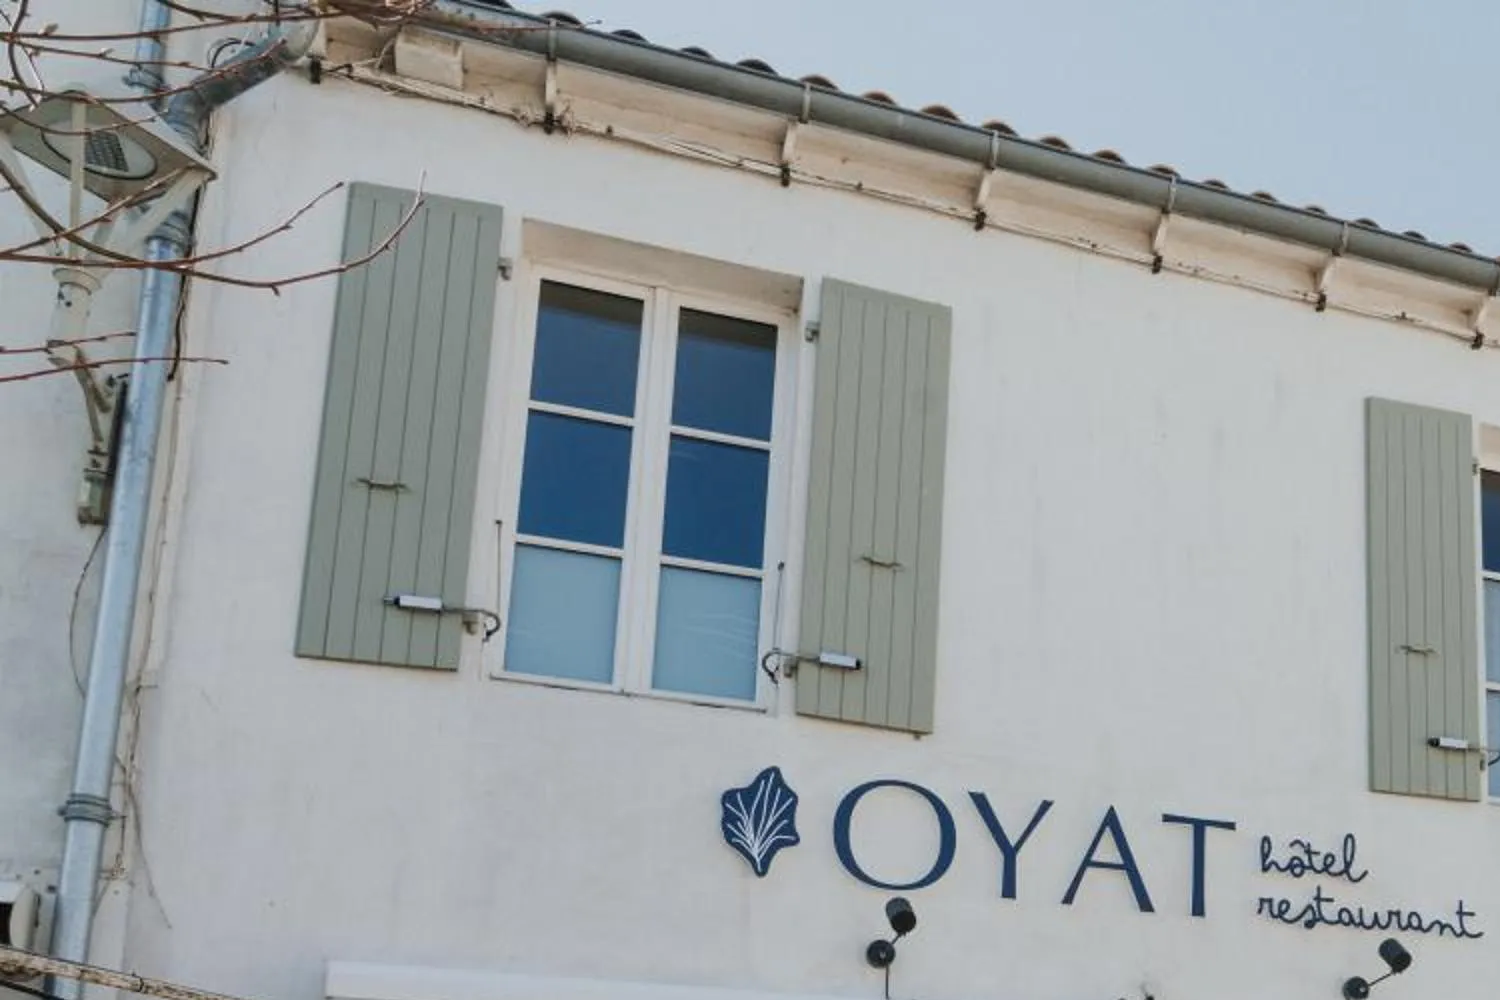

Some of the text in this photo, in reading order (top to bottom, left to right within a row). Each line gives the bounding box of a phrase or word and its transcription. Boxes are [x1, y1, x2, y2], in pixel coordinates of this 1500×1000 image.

[832, 779, 1237, 918] OYAT
[1258, 833, 1369, 882] hôtel
[1256, 886, 1484, 939] restaurant
